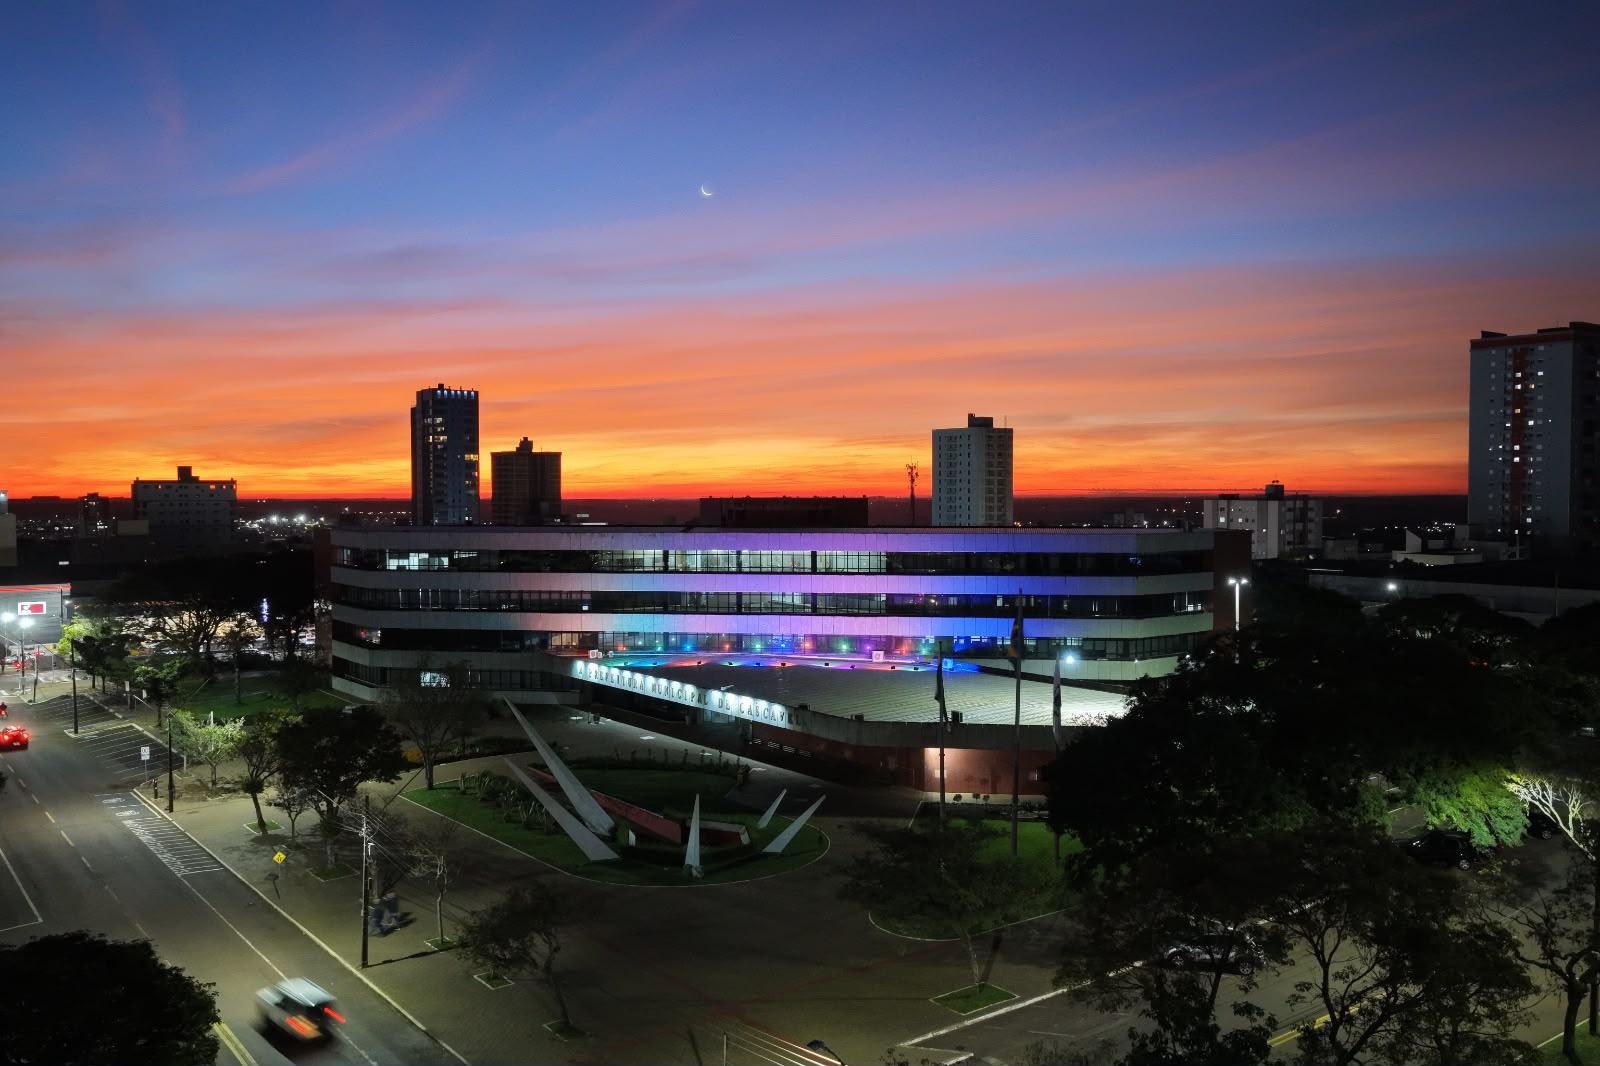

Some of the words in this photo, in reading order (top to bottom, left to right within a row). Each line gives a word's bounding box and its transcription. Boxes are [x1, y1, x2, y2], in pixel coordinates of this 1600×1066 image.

[651, 682, 709, 706] MUNICIPAL
[718, 697, 730, 711] DE
[739, 702, 802, 726] CASCAVEL
